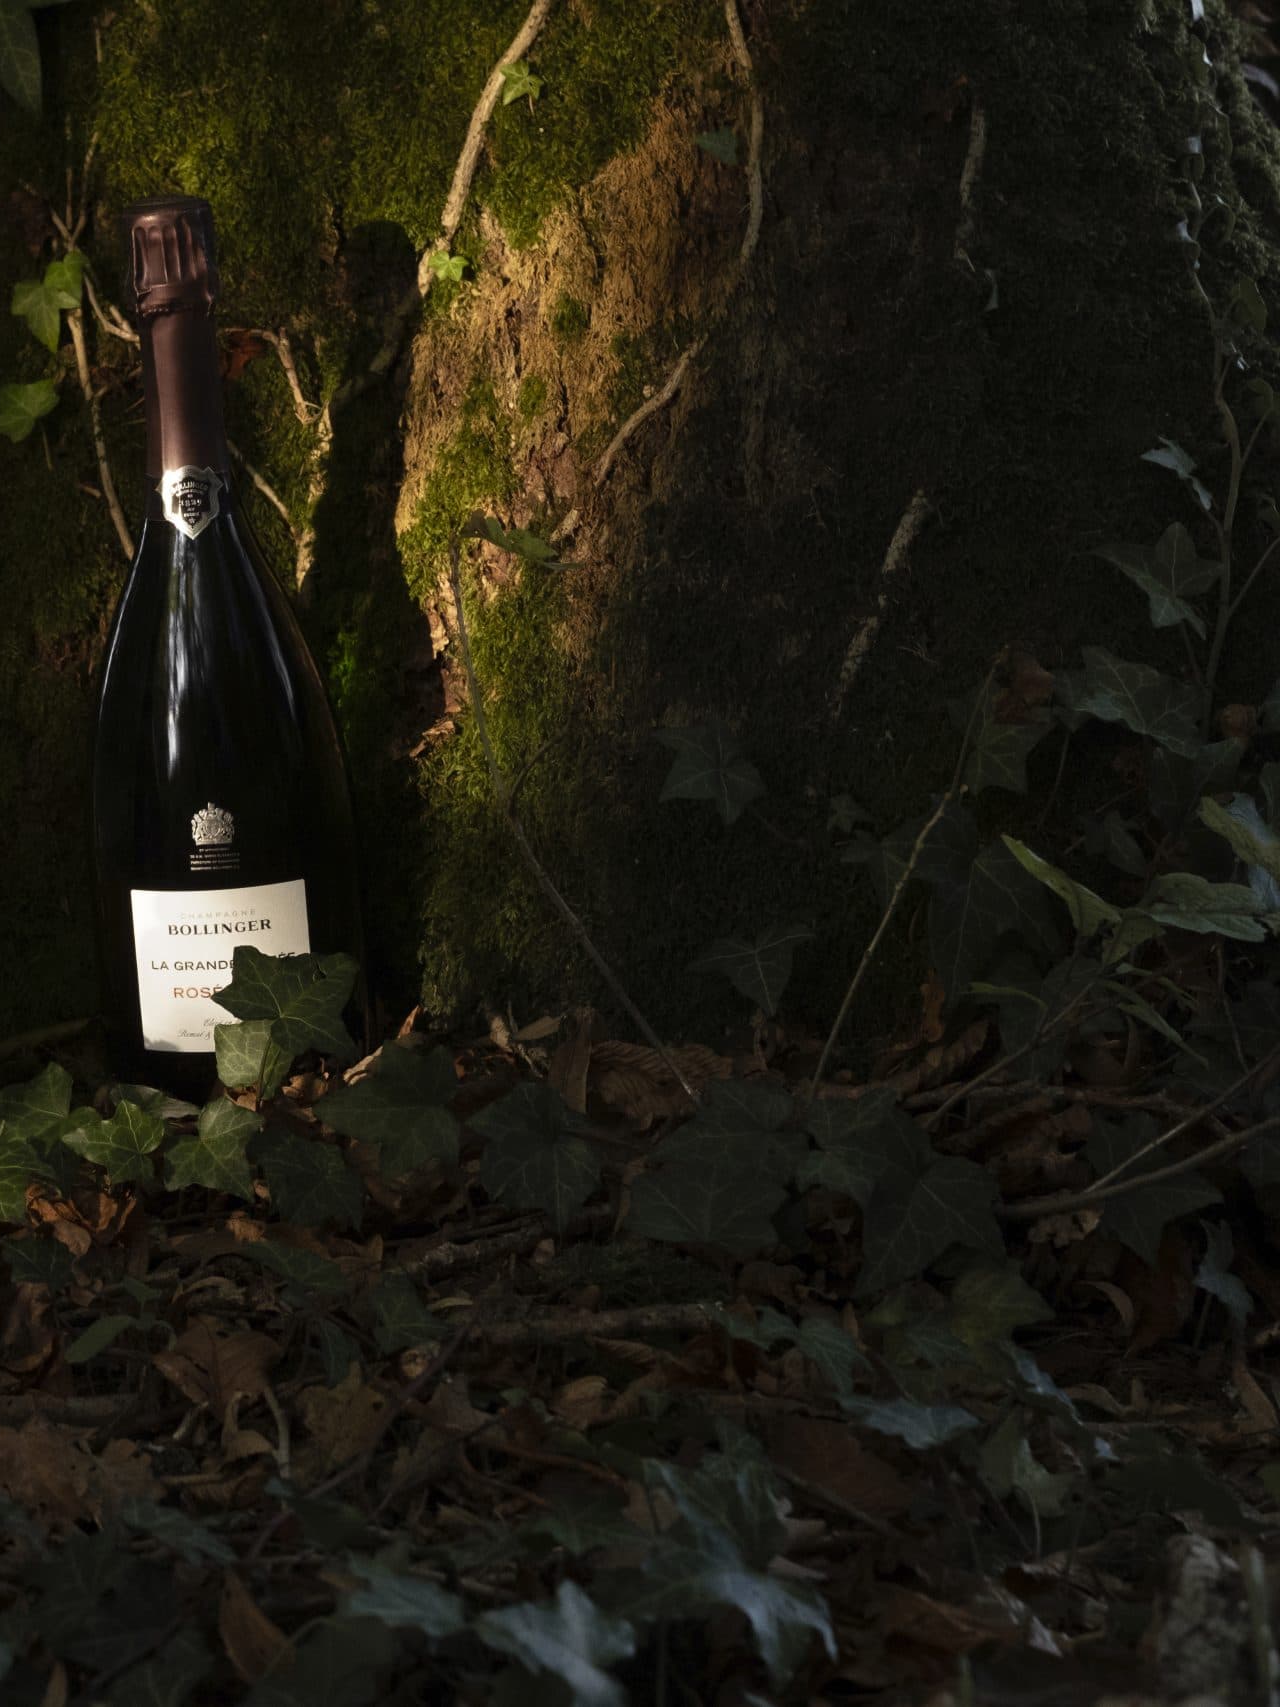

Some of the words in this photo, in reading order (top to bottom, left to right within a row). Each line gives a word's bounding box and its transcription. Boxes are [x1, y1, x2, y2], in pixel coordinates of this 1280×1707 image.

[180, 909, 256, 919] CHAMPAGNE
[168, 919, 272, 936] BOLLINGER
[151, 960, 169, 970] LA
